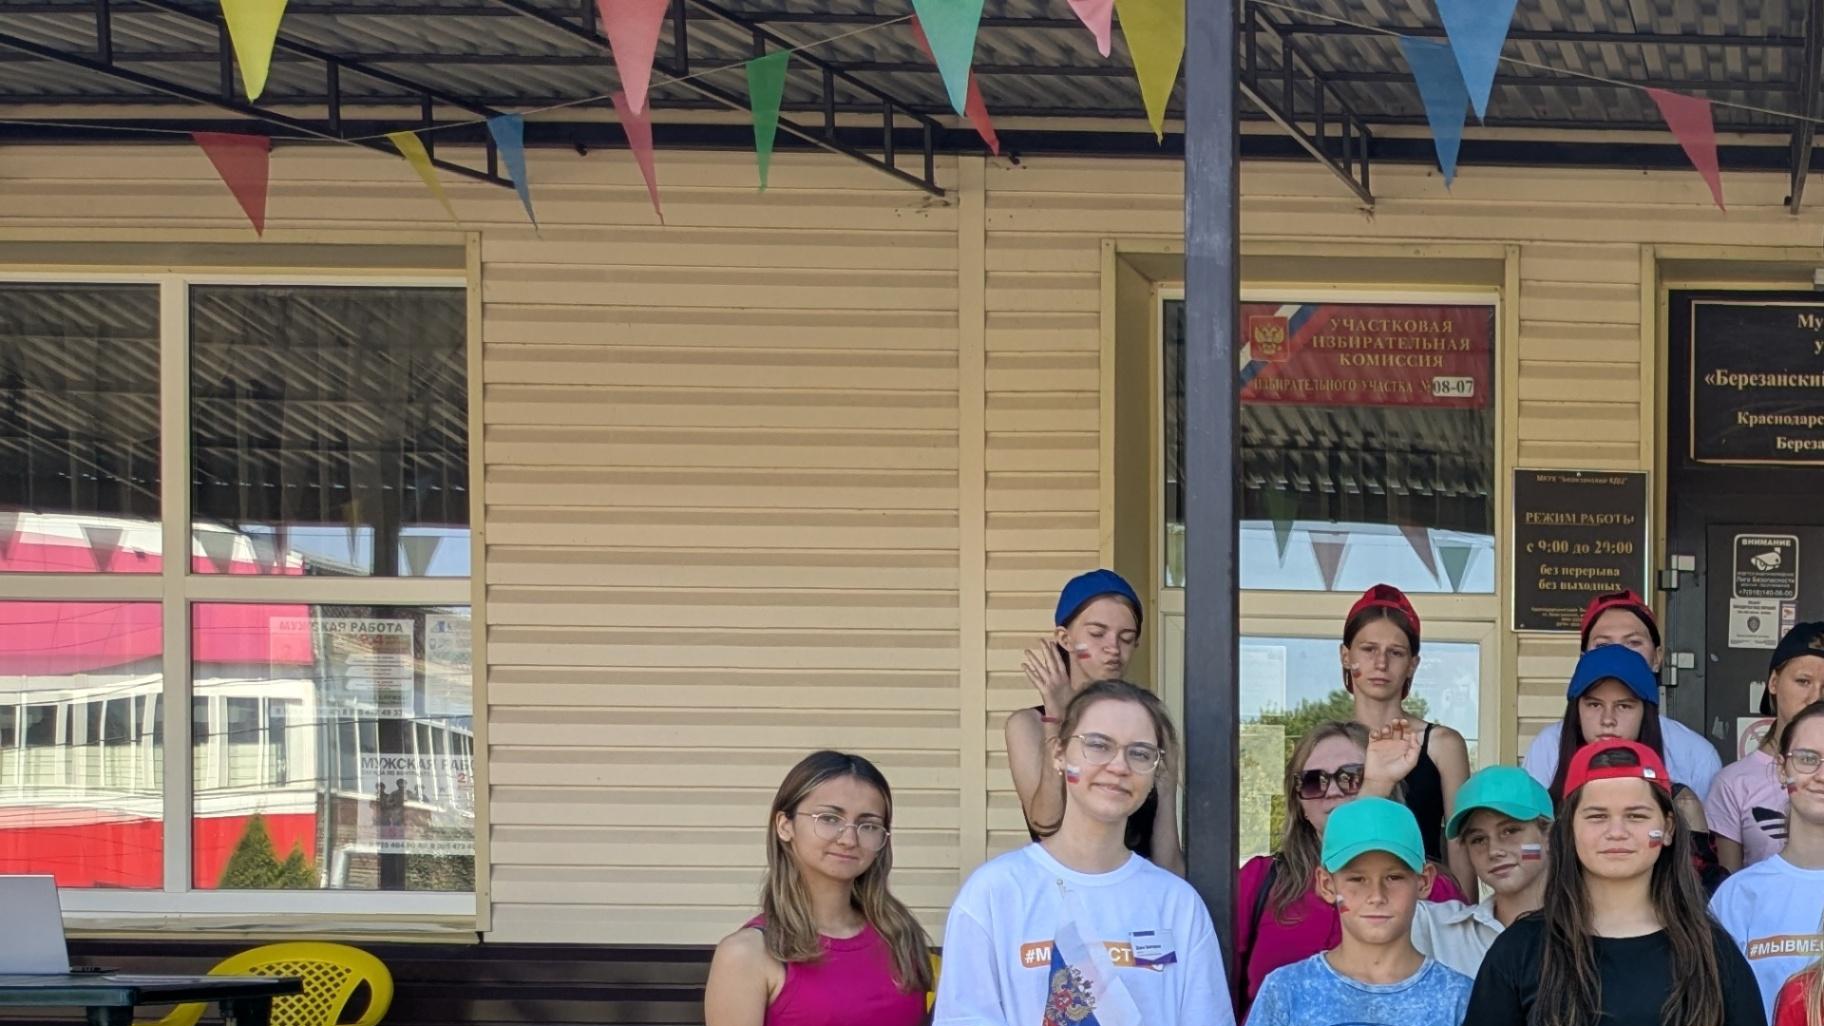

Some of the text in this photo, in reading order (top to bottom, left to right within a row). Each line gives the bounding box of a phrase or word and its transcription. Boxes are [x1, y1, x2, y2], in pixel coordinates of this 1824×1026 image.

[1330, 318, 1453, 333] УЧАСТКОВАЯ
[1312, 335, 1471, 351] ИЗБИРАТЕЛЬНАЯ
[1339, 352, 1444, 367] КОМИССИЯ
[1254, 378, 1357, 392] ИЗБИРАТЕЛЬНОГО
[1361, 379, 1413, 392] УЧАСТКА
[1433, 380, 1474, 394] 08-07
[1525, 511, 1635, 525] РЕЖИМ РАБОТЫ
[1538, 540, 1569, 553] 9:00
[1572, 543, 1590, 555] до
[1741, 538, 1792, 547] ВНИМАНИЕ
[1540, 564, 1620, 578] без перерыва
[1538, 578, 1622, 591] без выходных
[350, 621, 404, 633] РАБОТА
[441, 758, 474, 771] РАБ
